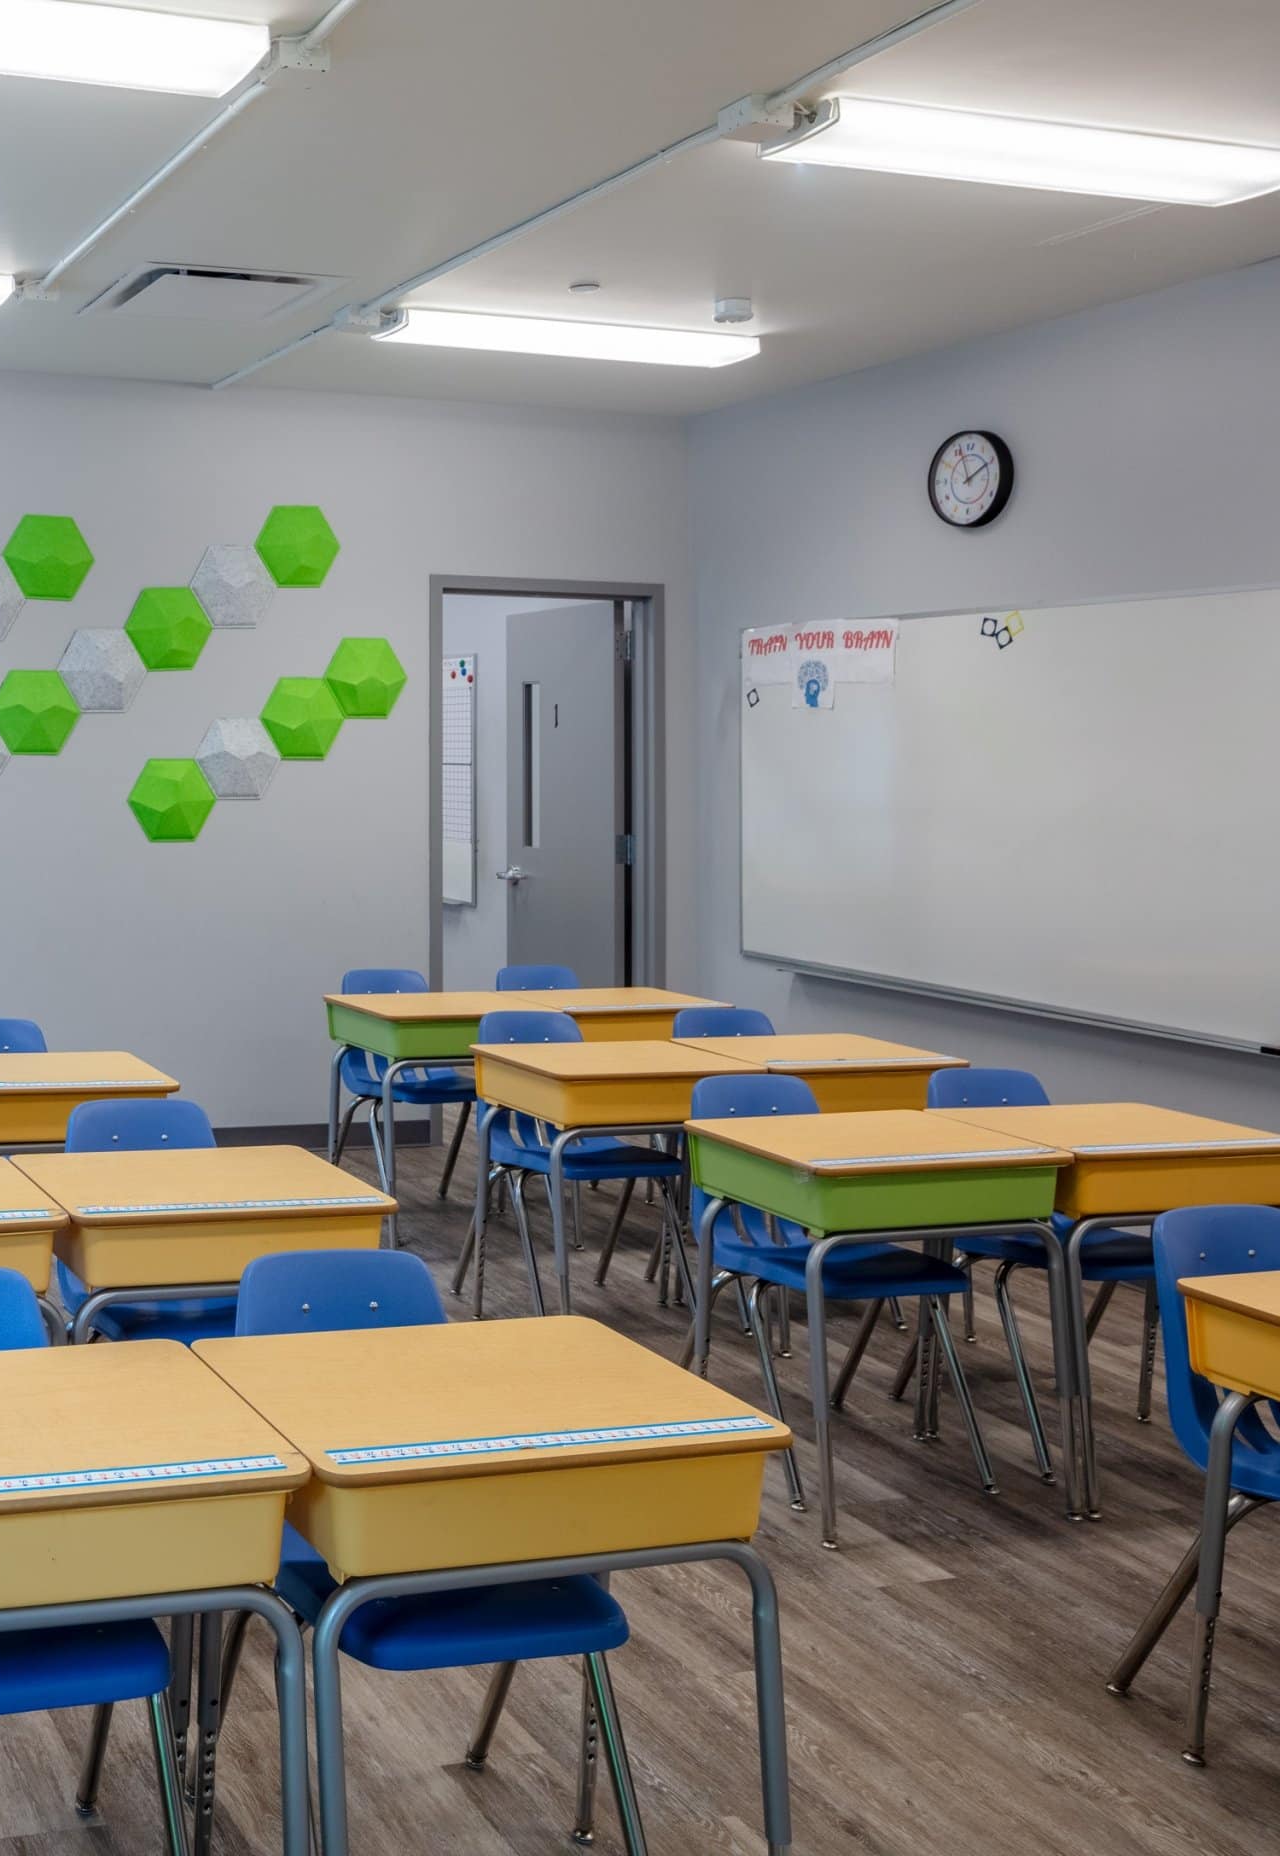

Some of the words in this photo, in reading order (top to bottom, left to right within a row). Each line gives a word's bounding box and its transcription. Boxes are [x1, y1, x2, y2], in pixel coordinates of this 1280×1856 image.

[748, 634, 788, 656] TRAIN
[794, 630, 835, 651] YOUR
[842, 629, 895, 651] BRAIN
